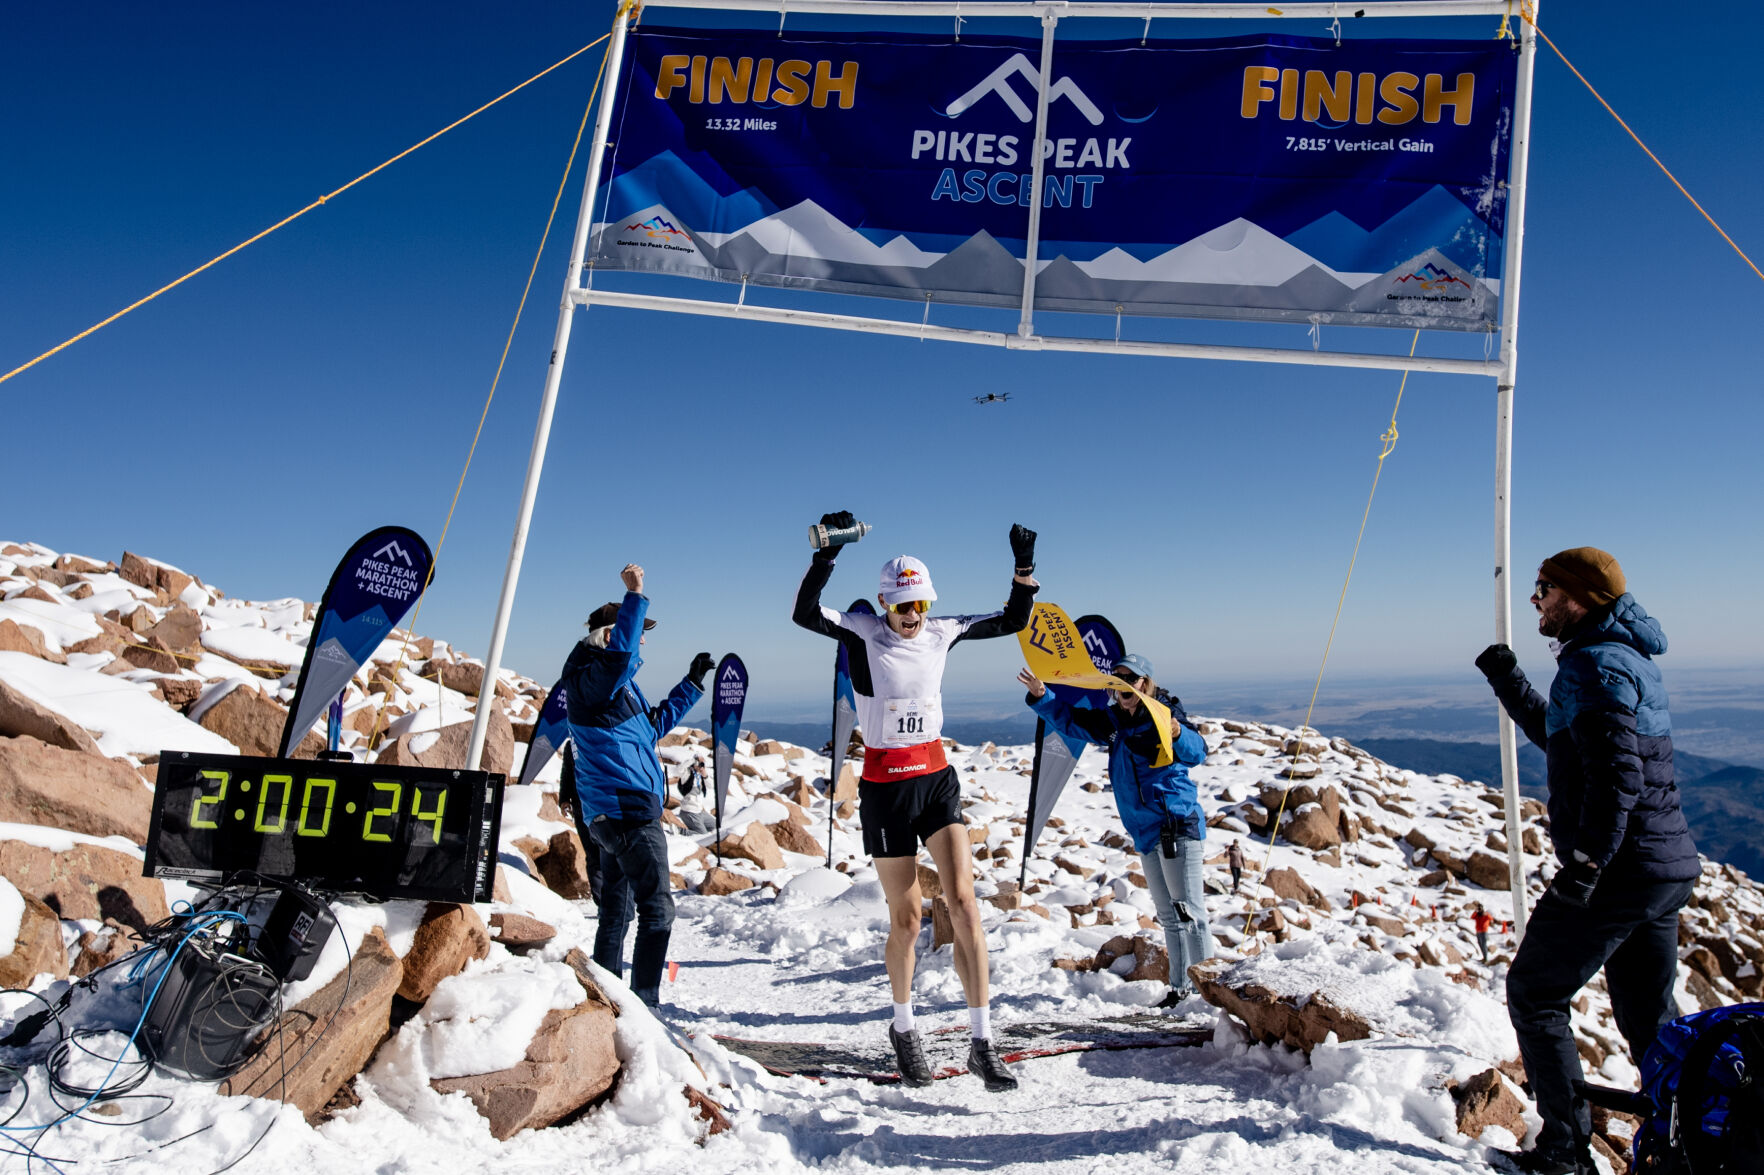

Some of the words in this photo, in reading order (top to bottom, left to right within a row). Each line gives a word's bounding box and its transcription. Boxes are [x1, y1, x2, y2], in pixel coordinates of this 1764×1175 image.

[654, 54, 859, 109] FINISH
[1240, 65, 1475, 126] FINISH
[705, 118, 741, 131] 13.32
[743, 118, 778, 131] Miles
[911, 129, 1019, 166] PIKES
[1031, 137, 1132, 168] PEAK
[1334, 138, 1394, 151] Vertical
[1398, 138, 1434, 153] Gain
[930, 167, 1104, 209] ASCENT
[664, 244, 694, 253] Challenge
[827, 526, 855, 536] SALOMO
[355, 567, 419, 592] MARATHON
[362, 558, 390, 574] PIKES
[390, 565, 418, 581] PEAK
[357, 581, 365, 590] +
[366, 582, 411, 601] ASCENT
[896, 579, 910, 588] Red
[910, 578, 923, 586] Bull
[1038, 608, 1056, 631] PEAK
[1049, 611, 1075, 650] ASCENT
[1051, 631, 1068, 660] PIKES
[897, 717, 924, 734] 101
[887, 763, 927, 774] SALOMON
